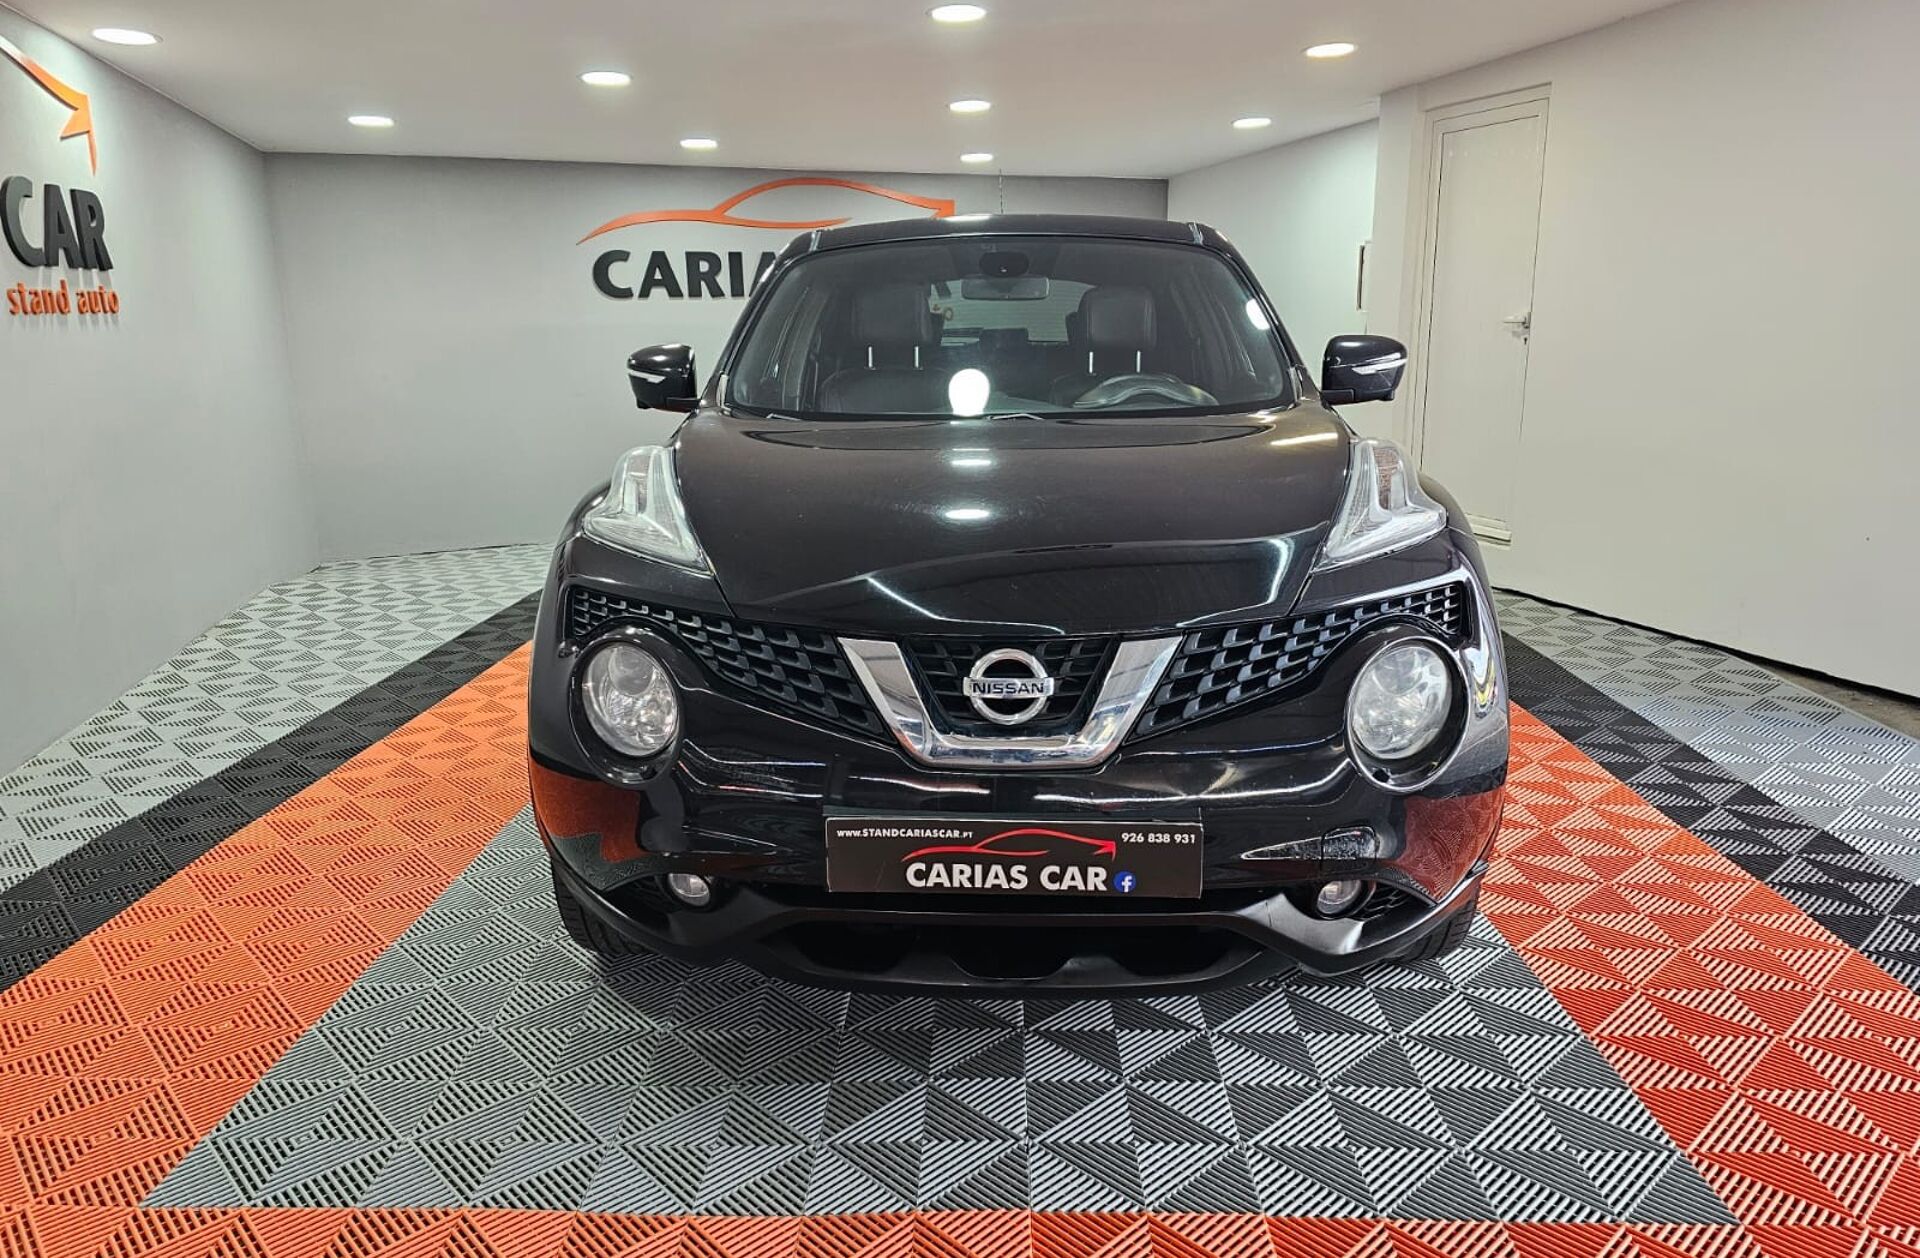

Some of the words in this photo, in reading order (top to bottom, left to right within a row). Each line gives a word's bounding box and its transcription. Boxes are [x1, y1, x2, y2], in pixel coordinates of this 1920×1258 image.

[0, 176, 113, 271] CAR
[592, 249, 776, 299] CARI
[6, 280, 71, 315] stand
[76, 286, 120, 315] auto
[972, 682, 1044, 694] NISSAN
[836, 828, 974, 839] www.STANDCARIASCAR.PT
[1121, 832, 1145, 843] 926
[1147, 833, 1171, 844] 838
[1174, 833, 1196, 844] 931
[905, 861, 1028, 890] CARIAS
[1039, 865, 1108, 892] CAR
